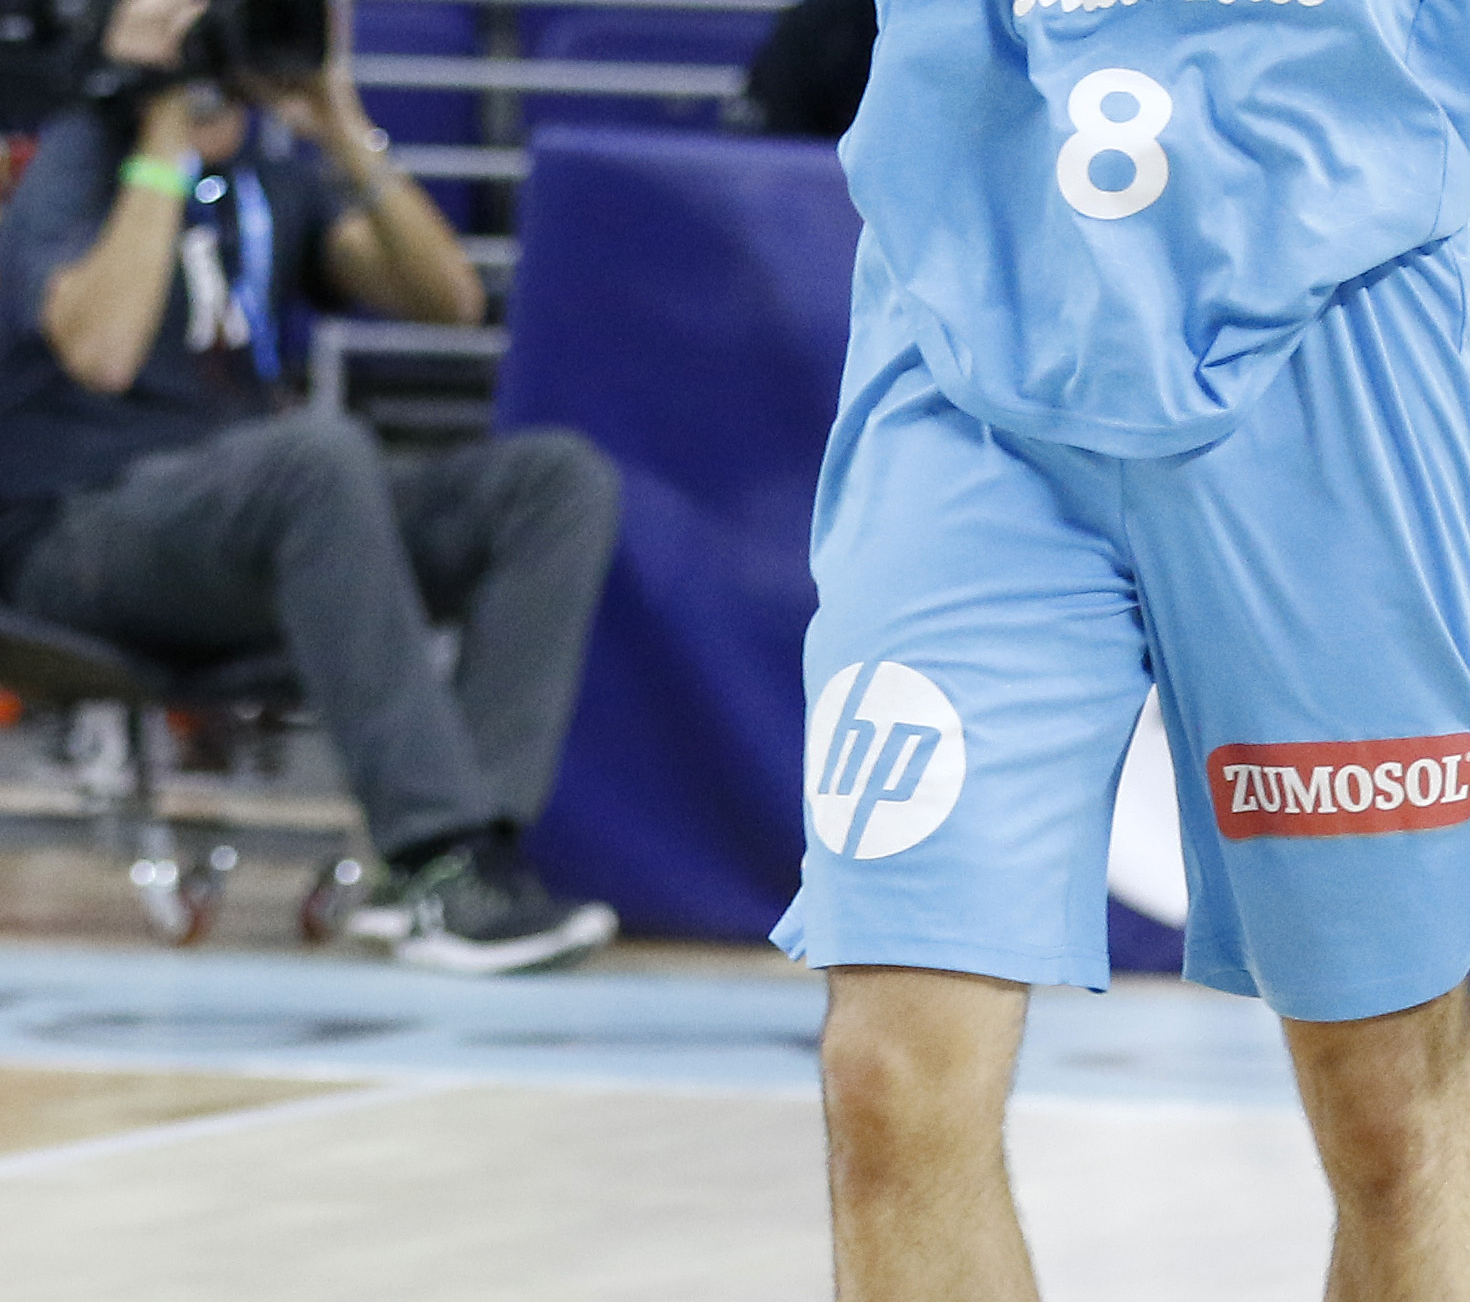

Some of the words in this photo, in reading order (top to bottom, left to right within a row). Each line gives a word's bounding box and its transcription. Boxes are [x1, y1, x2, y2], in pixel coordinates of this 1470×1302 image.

[1056, 67, 1173, 221] 8
[817, 660, 943, 860] hp
[1222, 753, 1470, 814] ZUMOSOL
